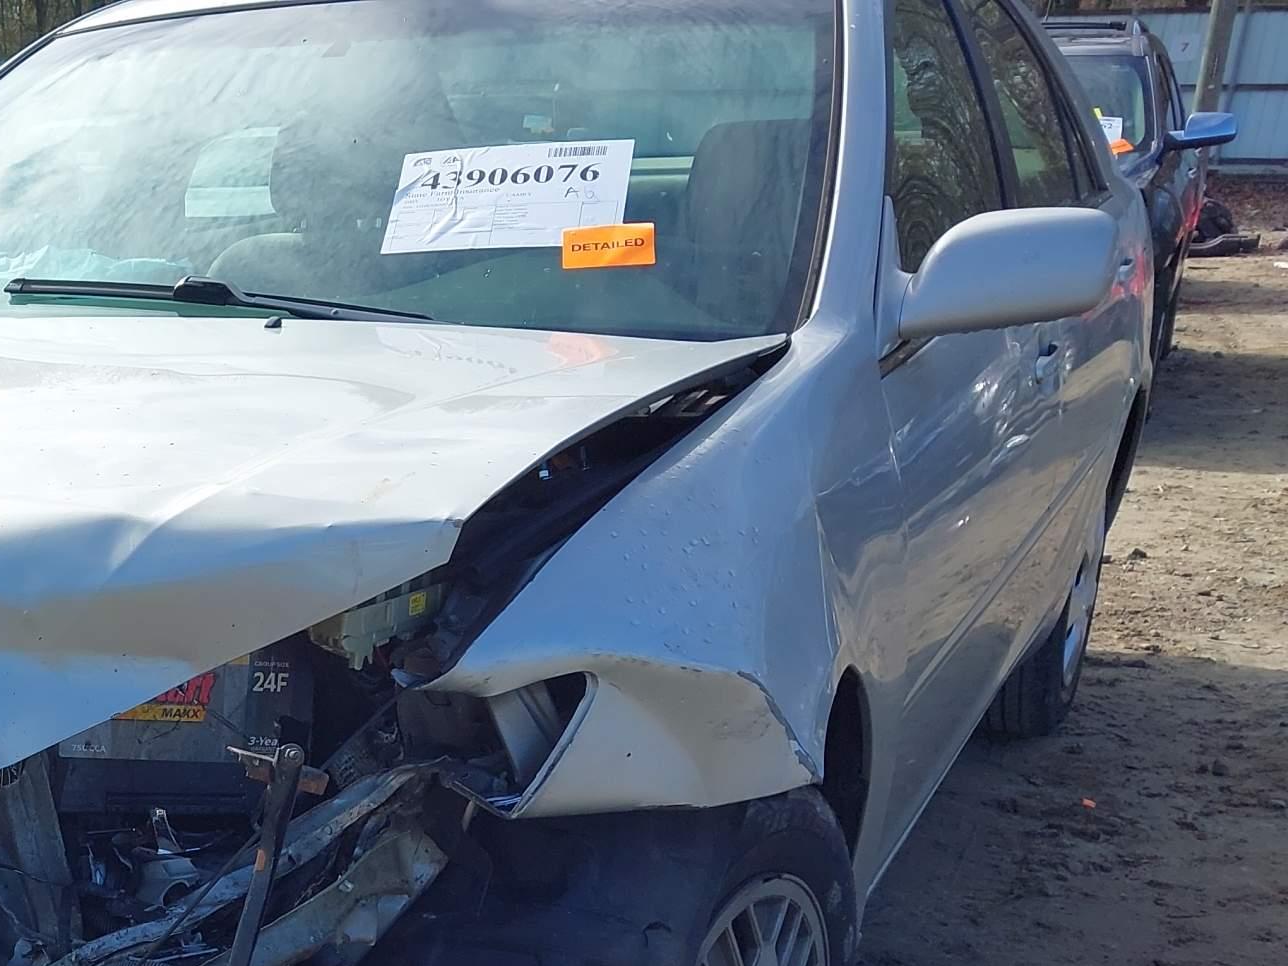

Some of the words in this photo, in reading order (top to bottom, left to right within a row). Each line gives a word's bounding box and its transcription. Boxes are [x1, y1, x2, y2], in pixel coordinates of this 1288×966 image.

[421, 161, 601, 190] 43906076
[571, 237, 645, 253] DETAILED
[252, 671, 290, 693] 24F
[247, 736, 279, 747] 3-Yea
